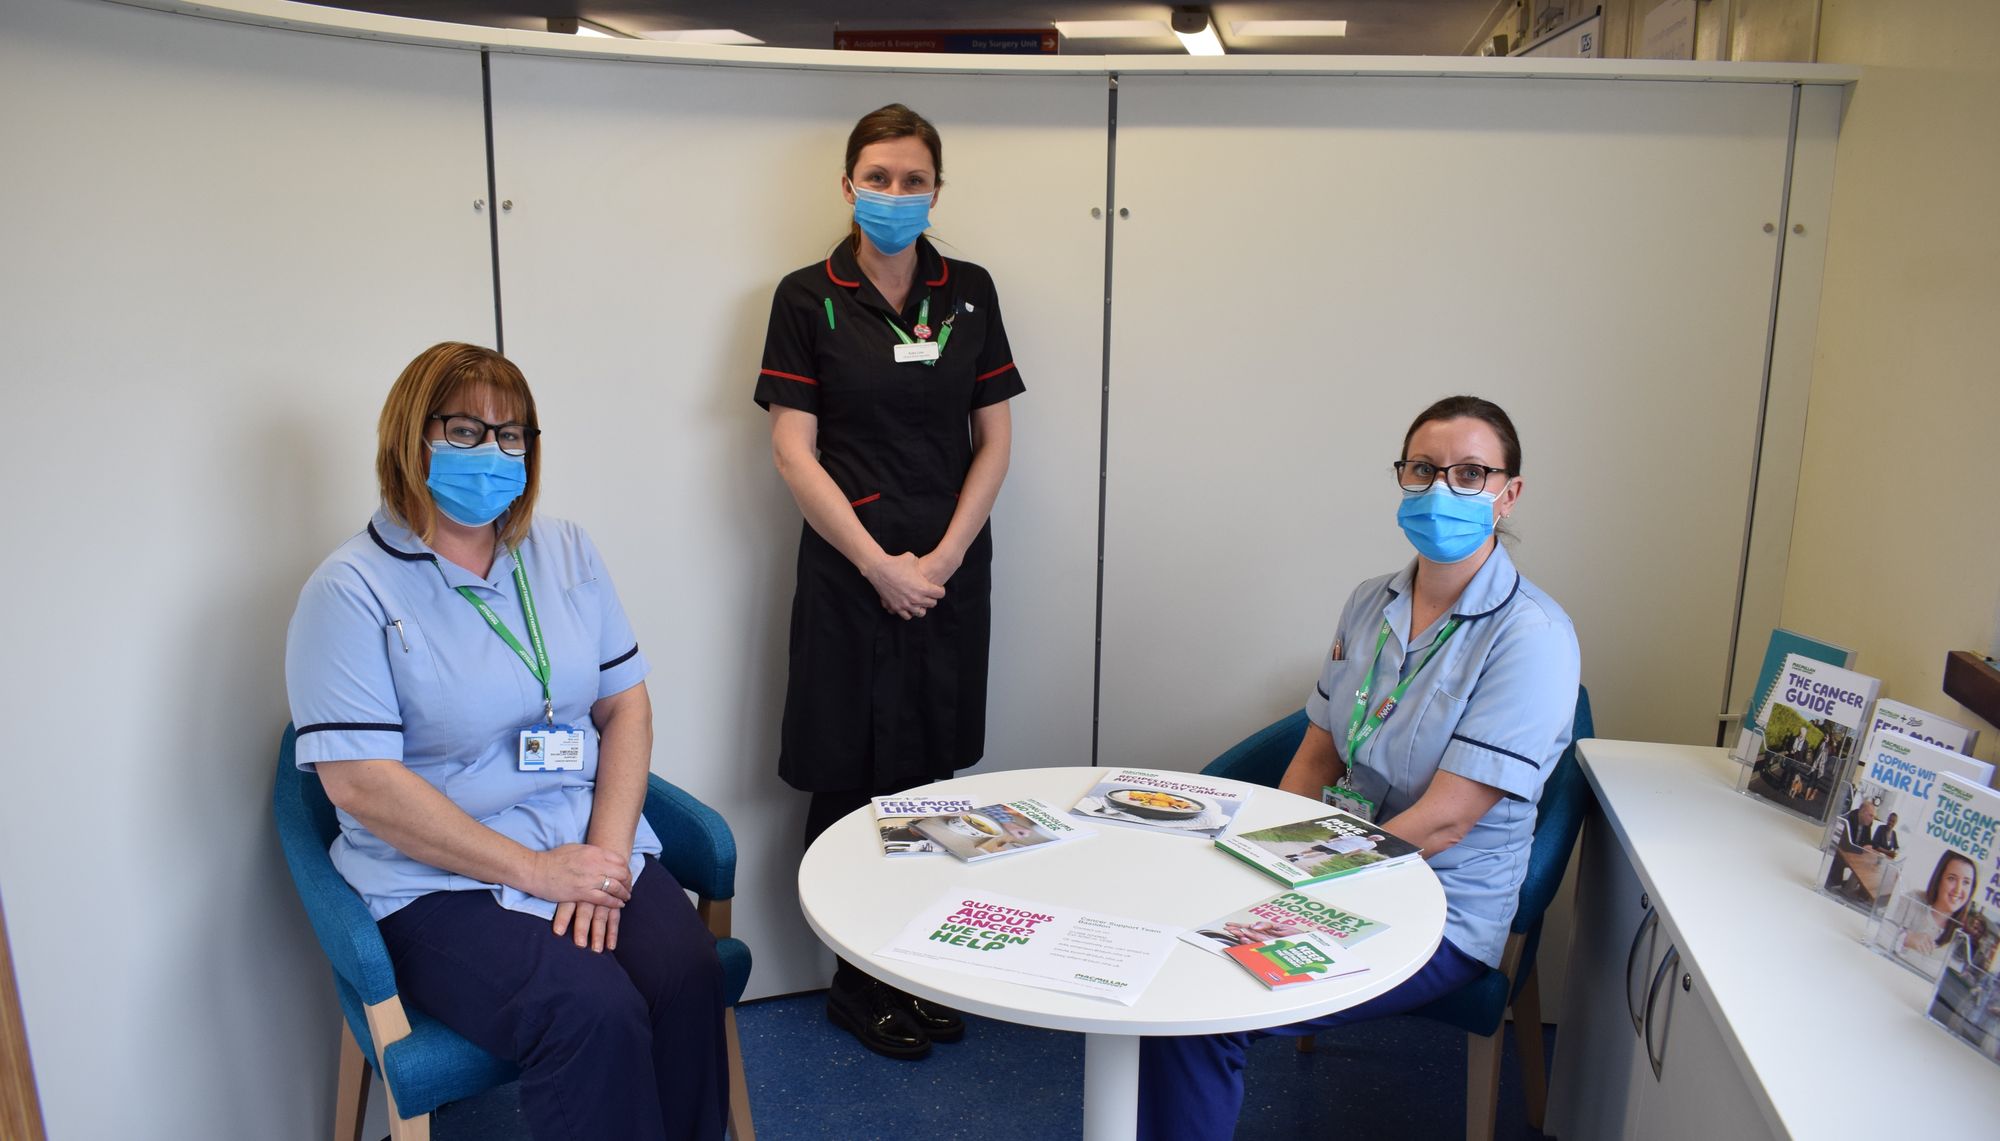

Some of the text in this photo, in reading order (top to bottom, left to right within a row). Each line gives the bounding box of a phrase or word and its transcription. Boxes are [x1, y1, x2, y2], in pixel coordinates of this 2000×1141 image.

[855, 40, 937, 49] Accident & Emergency
[972, 40, 1038, 49] Day Surgery Unit
[1789, 672, 1864, 709] THE CANCER
[1379, 701, 1394, 719] NHS
[1785, 688, 1836, 716] GUIDE
[1878, 753, 1917, 775] COPING
[1113, 777, 1168, 788] AFFECTED
[1189, 788, 1238, 798] CANCER
[1118, 774, 1158, 783] RECIPES
[1181, 783, 1216, 791] PEOPLE
[1871, 762, 1912, 793] HAIR
[1937, 794, 1962, 816] THE
[1007, 802, 1029, 812] AND
[1026, 810, 1061, 832] CANCER
[1325, 818, 1368, 835] MOVE
[1933, 810, 1982, 842] GUIDE
[1926, 822, 1969, 852] YOUNG
[955, 907, 1042, 929] ABOUT
[961, 899, 1055, 923] QUESTIONS
[1248, 906, 1298, 927] HELP
[1259, 902, 1349, 939] HOW WE CAN
[1270, 898, 1359, 935] WORRIES?
[1280, 892, 1374, 929] MONEY
[940, 922, 1031, 945] WE CAN
[946, 915, 1036, 937] CANCER?
[1080, 916, 1107, 925] Cancer
[1109, 921, 1139, 930] Support
[1141, 926, 1162, 934] Team
[928, 930, 1006, 952] HELP
[1296, 945, 1326, 962] KEEP
[1075, 973, 1128, 987] MACMILLAN
